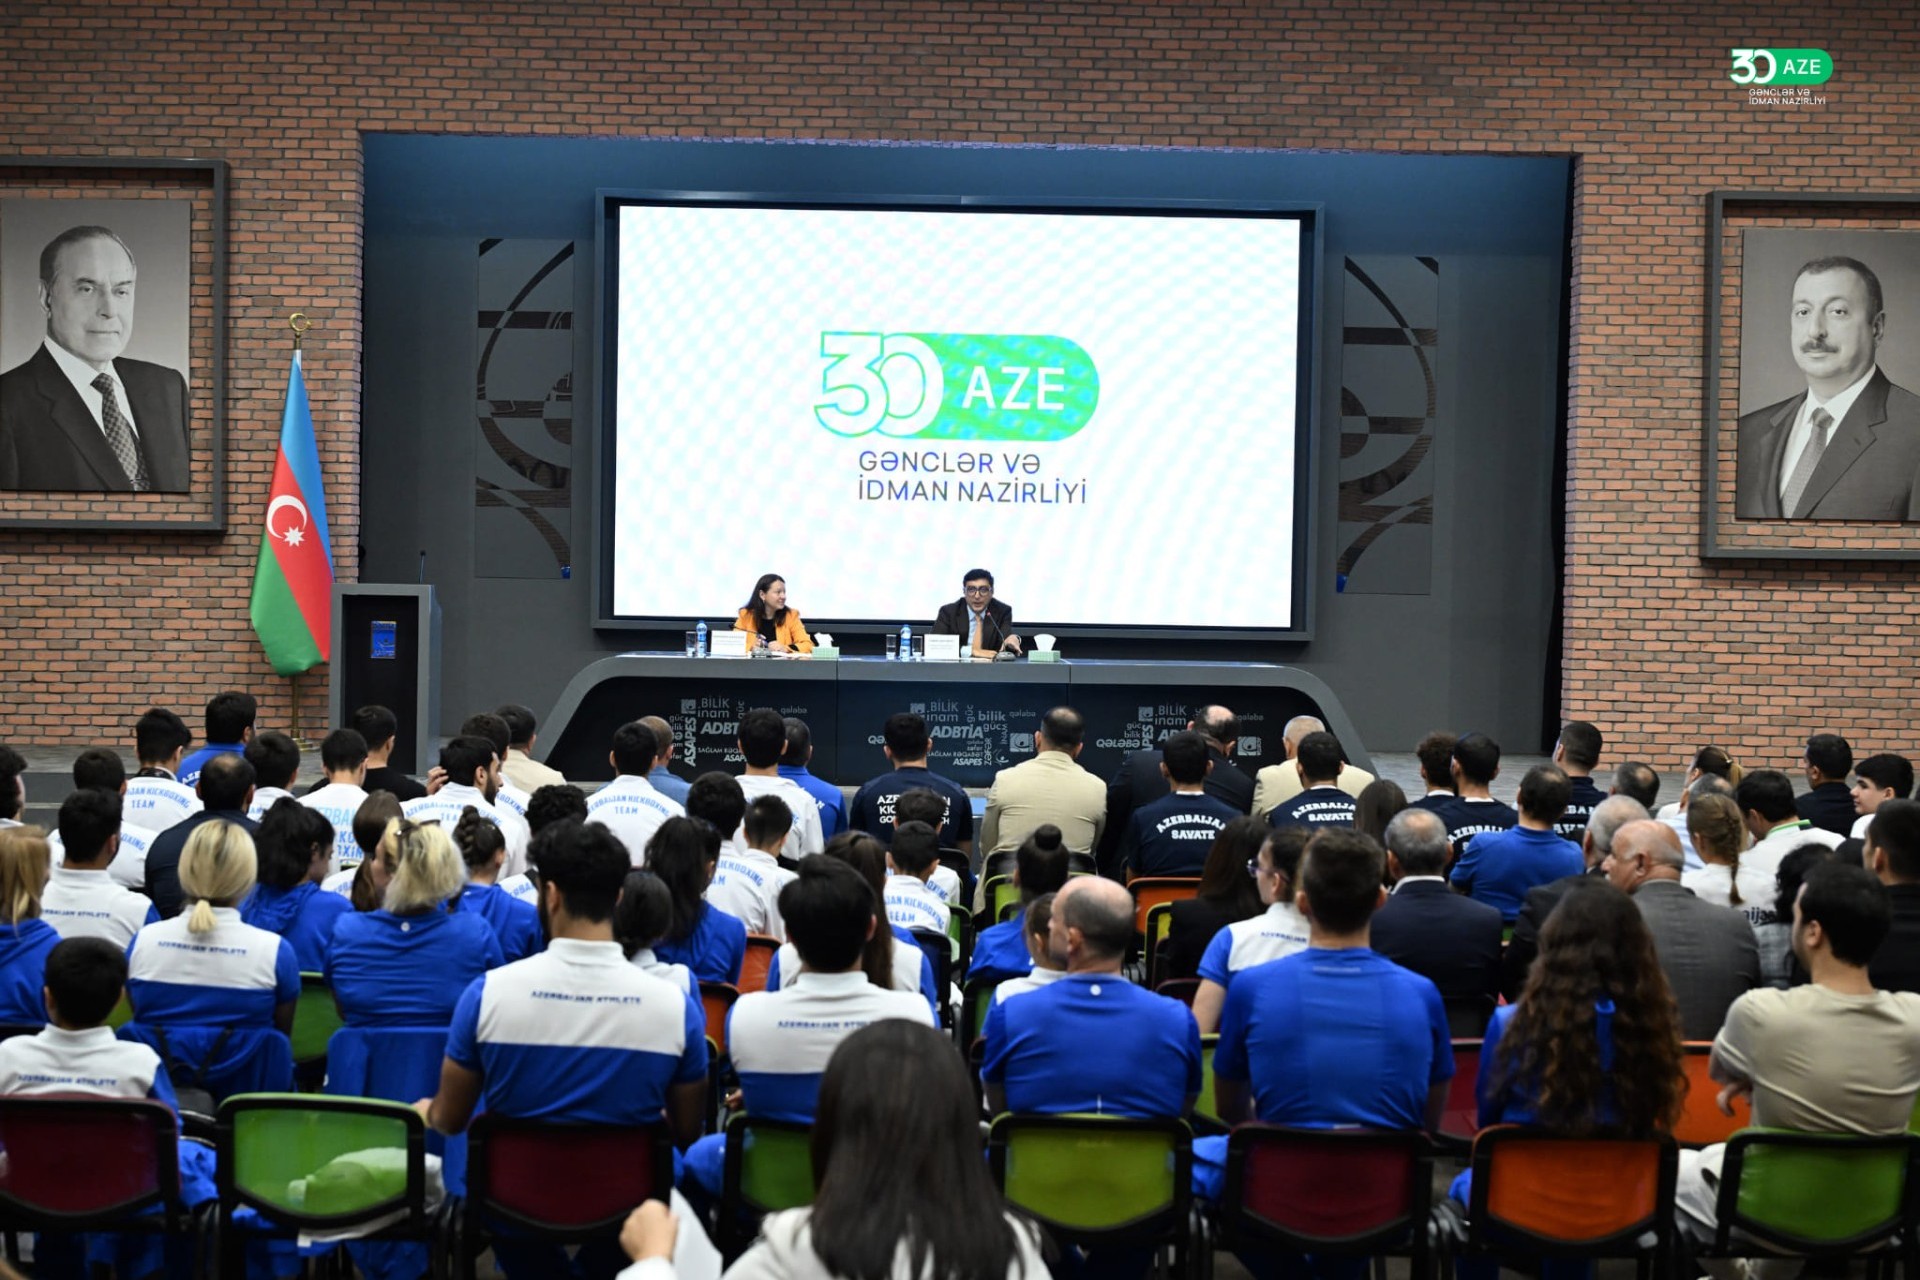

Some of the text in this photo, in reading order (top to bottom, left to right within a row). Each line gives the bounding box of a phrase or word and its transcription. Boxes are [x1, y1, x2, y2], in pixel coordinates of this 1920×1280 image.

[814, 331, 1065, 438] 30 AZE
[859, 451, 1040, 474] GƏNCLƏR VƏ
[859, 474, 1087, 504] İDMAN NAZİRLİYİ
[697, 706, 730, 718] inam
[926, 710, 959, 722] inam
[978, 710, 1006, 722] bilik
[1154, 714, 1187, 726] inam
[930, 722, 984, 739] ADBTİA
[983, 721, 1001, 732] güc
[684, 717, 696, 767] ASAPES
[1096, 739, 1141, 748] QƏLƏBƏ
[953, 758, 984, 766] ASAPES
[132, 800, 155, 809] TEAM
[615, 806, 638, 814] TEAM
[1308, 812, 1354, 822] SAVATE
[1171, 829, 1216, 840] SAVATE
